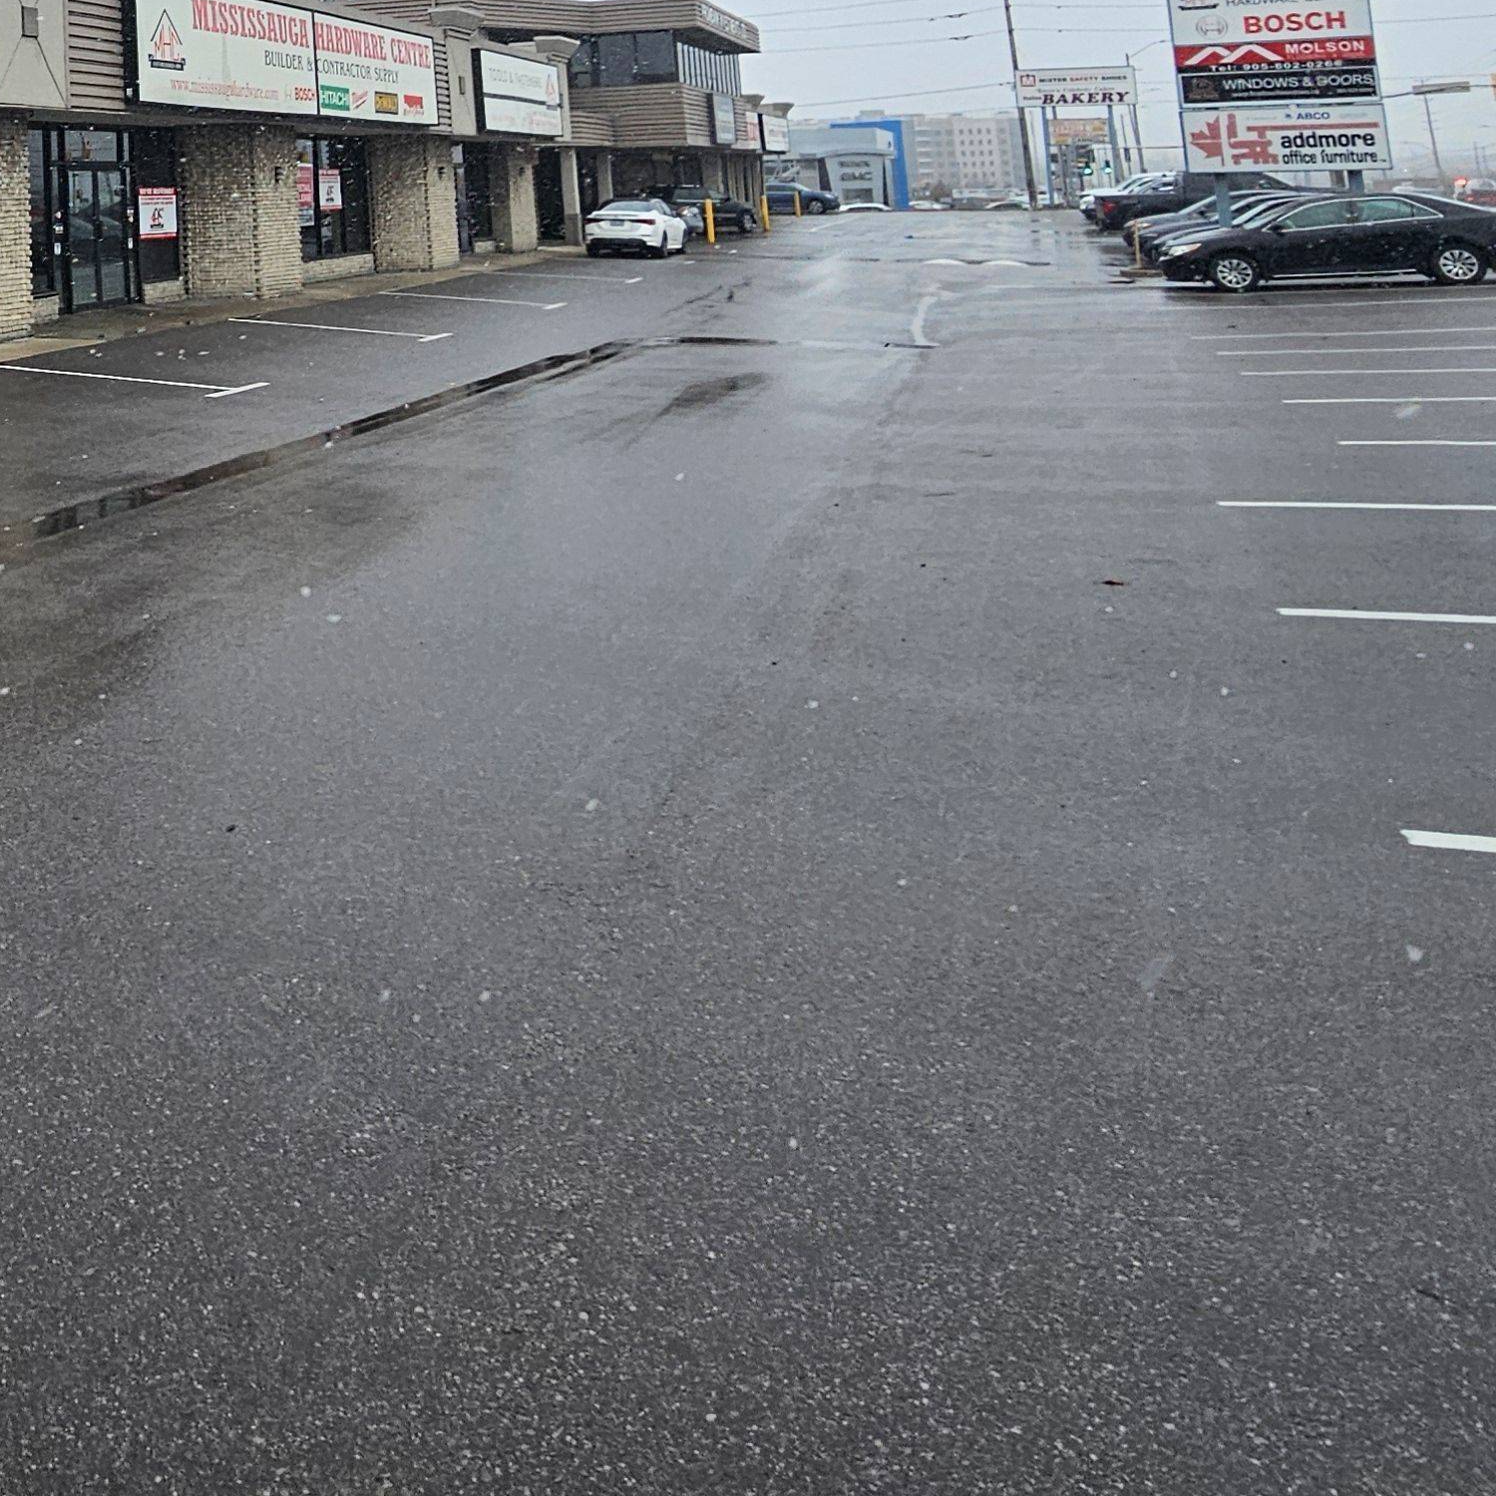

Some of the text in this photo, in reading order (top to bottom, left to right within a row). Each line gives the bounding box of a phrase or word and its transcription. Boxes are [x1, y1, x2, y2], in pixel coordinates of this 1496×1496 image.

[1243, 11, 1347, 35] BOSCH
[315, 21, 387, 62] HARDWARE
[390, 37, 432, 70] CENTRE
[1285, 40, 1366, 54] MOLSON
[264, 49, 304, 72] BUILDER
[317, 58, 373, 81] CONTRACTOR
[1222, 76, 1300, 90] WINDOWS
[294, 86, 316, 102] BOSCH
[1042, 91, 1131, 105] BAKERY
[1296, 111, 1331, 120] ABCO
[1280, 131, 1376, 149] addmore
[1282, 150, 1378, 165] office furniture
